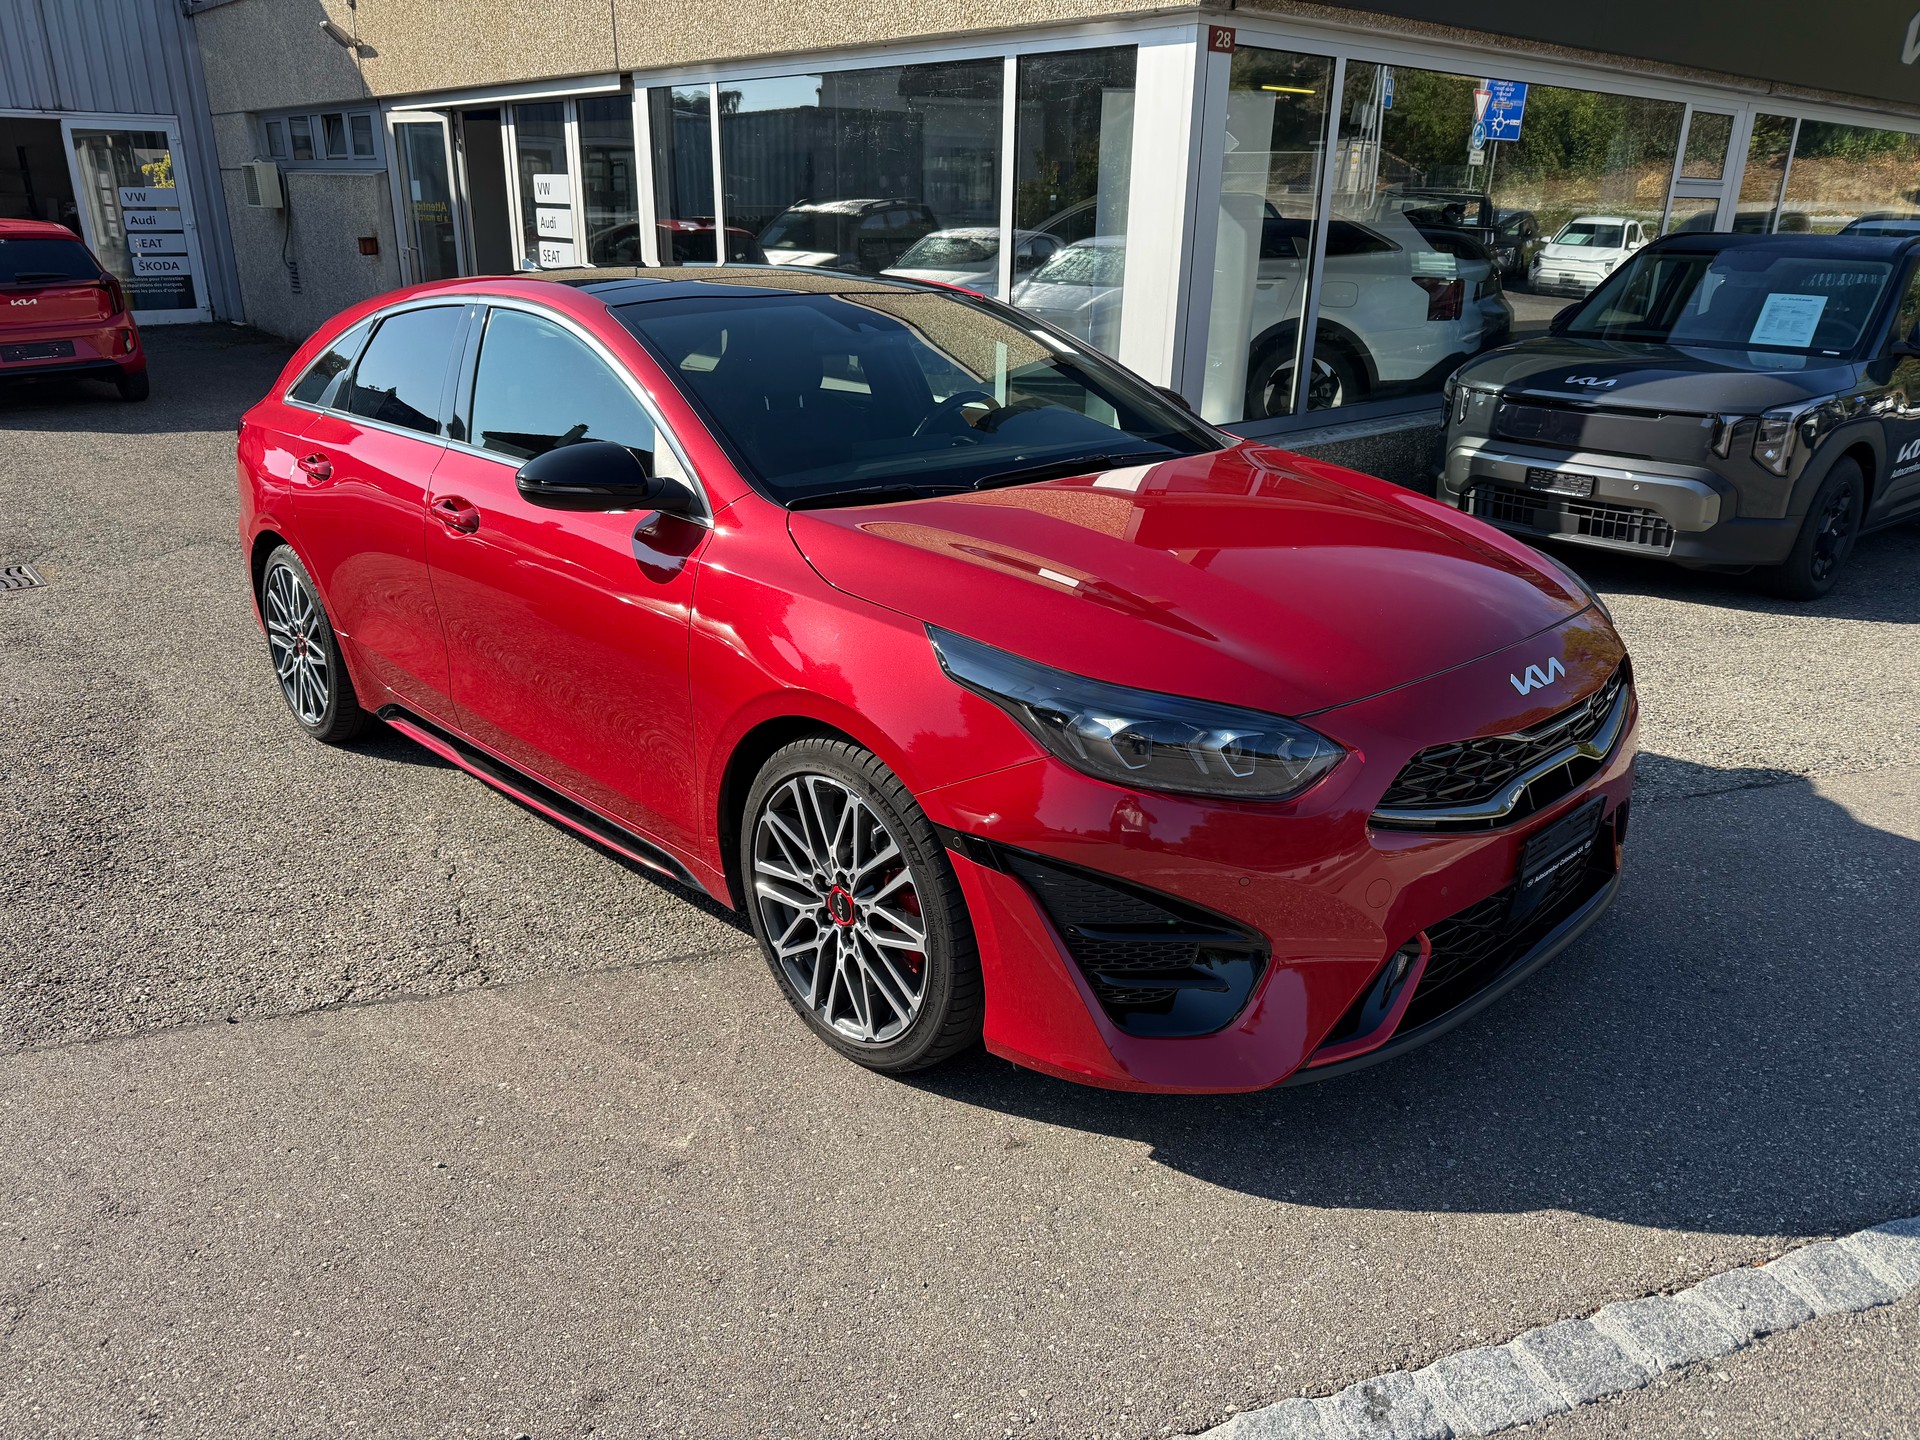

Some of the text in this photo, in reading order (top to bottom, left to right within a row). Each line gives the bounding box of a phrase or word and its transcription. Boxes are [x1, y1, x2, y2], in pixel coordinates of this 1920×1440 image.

[1215, 30, 1231, 48] 28
[537, 182, 551, 196] VW
[124, 192, 146, 202] VW
[130, 215, 157, 225] Audi
[540, 217, 557, 229] Audi
[543, 249, 560, 263] SEAT
[138, 259, 180, 271] ŠKODA
[10, 298, 38, 306] KIA
[1564, 375, 1618, 387] KIA
[1510, 656, 1566, 696] KIA
